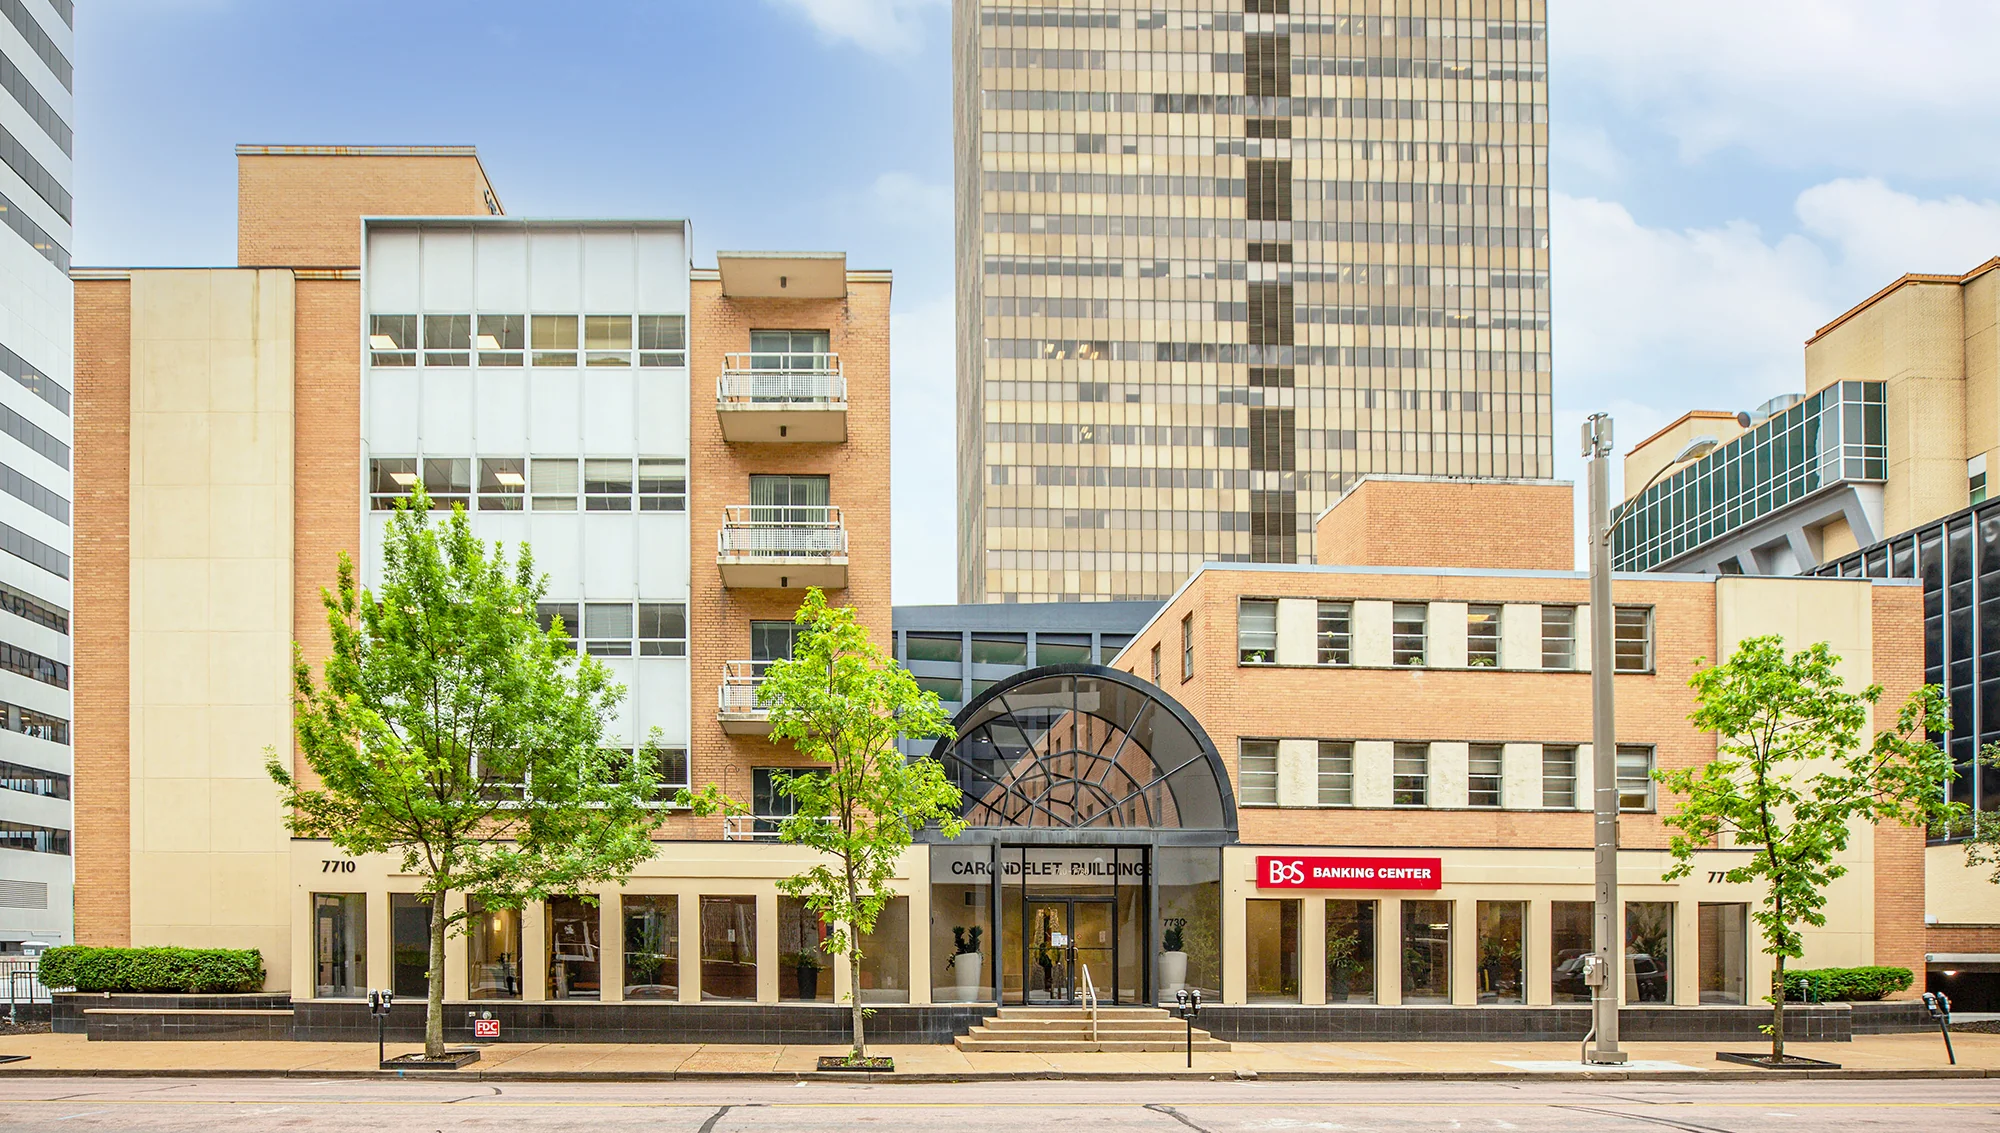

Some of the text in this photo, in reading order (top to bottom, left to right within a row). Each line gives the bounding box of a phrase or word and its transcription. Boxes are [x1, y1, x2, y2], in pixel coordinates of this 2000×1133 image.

[321, 860, 356, 873] 7710
[1070, 862, 1151, 876] BUILDING
[1313, 867, 1375, 879] BANKING
[1378, 868, 1432, 879] CENTER
[1163, 917, 1186, 927] 7730
[477, 1022, 498, 1031] FDC
